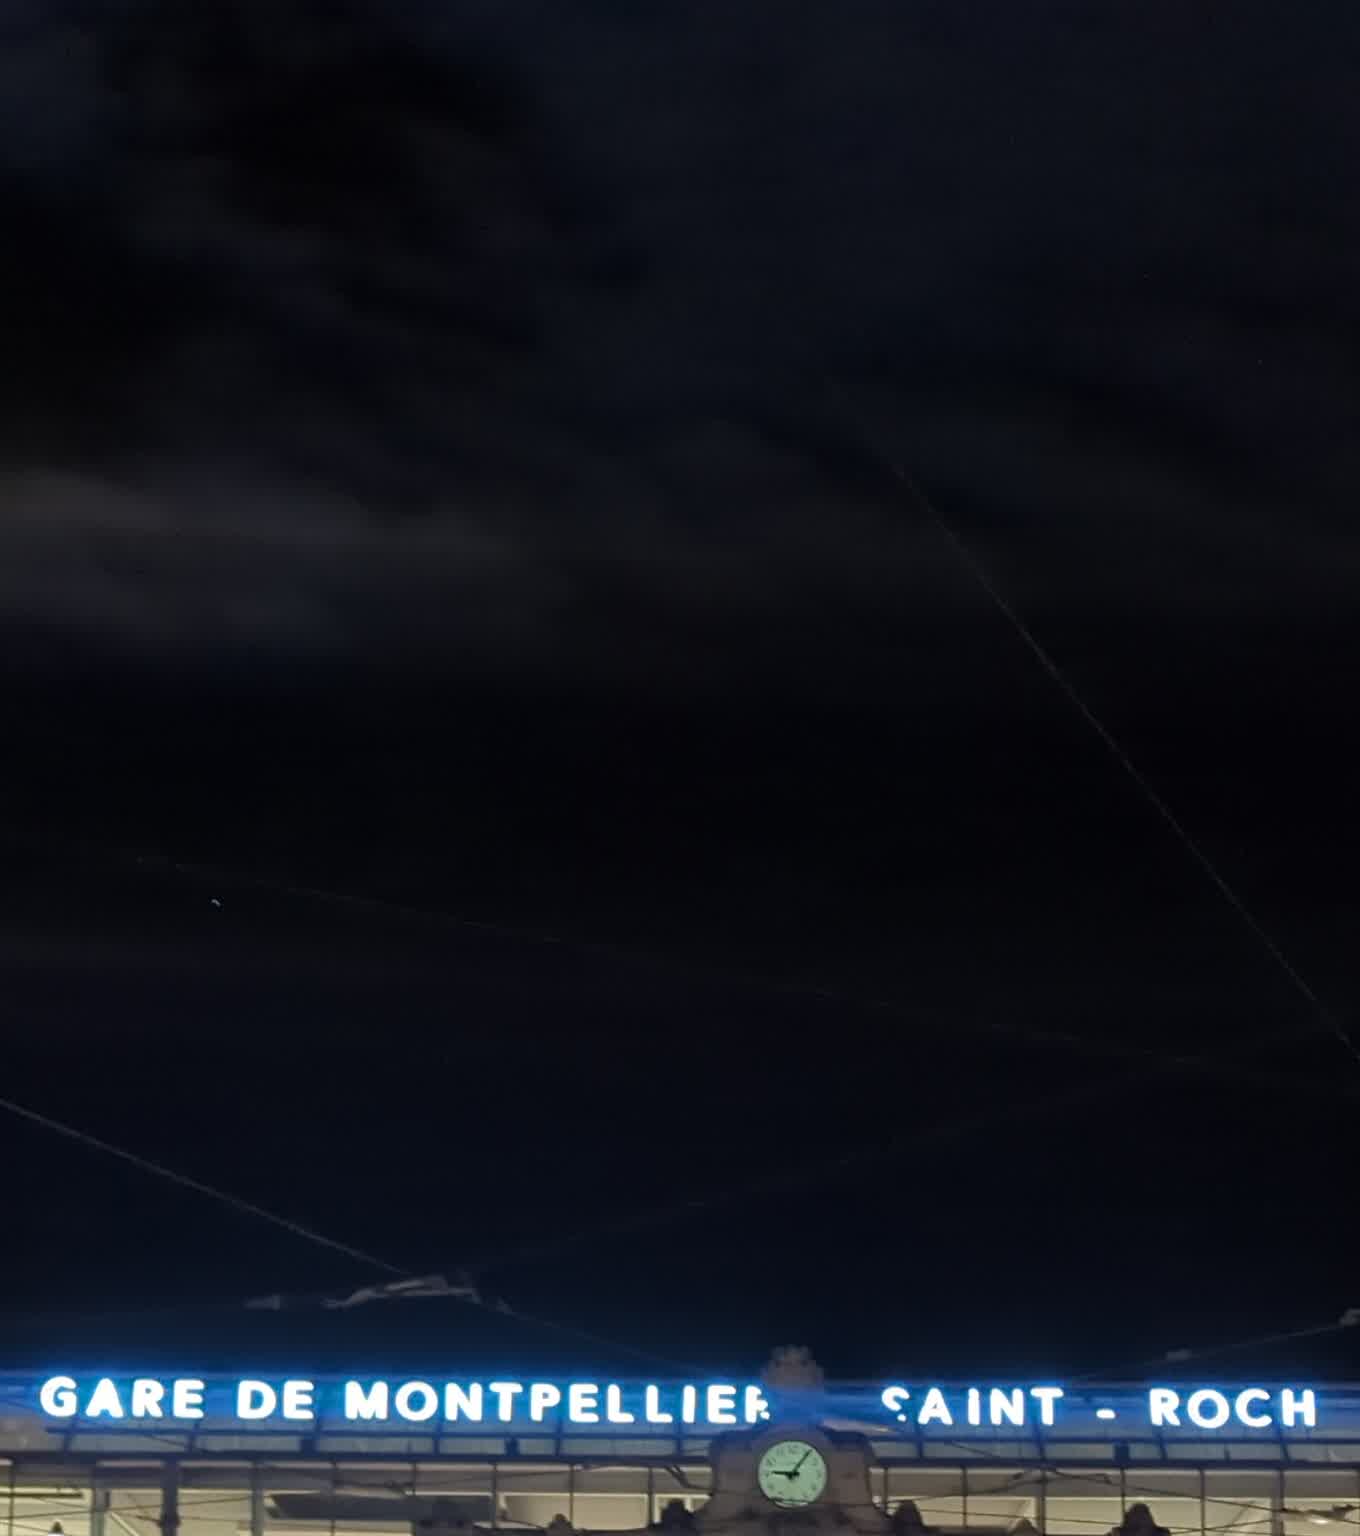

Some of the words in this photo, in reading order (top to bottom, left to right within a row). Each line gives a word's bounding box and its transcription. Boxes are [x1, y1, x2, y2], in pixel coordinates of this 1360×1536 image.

[40, 1376, 204, 1420] GARE
[237, 1379, 314, 1420] DE
[345, 1381, 771, 1425] MONTPELLIER
[881, 1386, 1064, 1427] SAINT
[1149, 1388, 1316, 1430] ROCH
